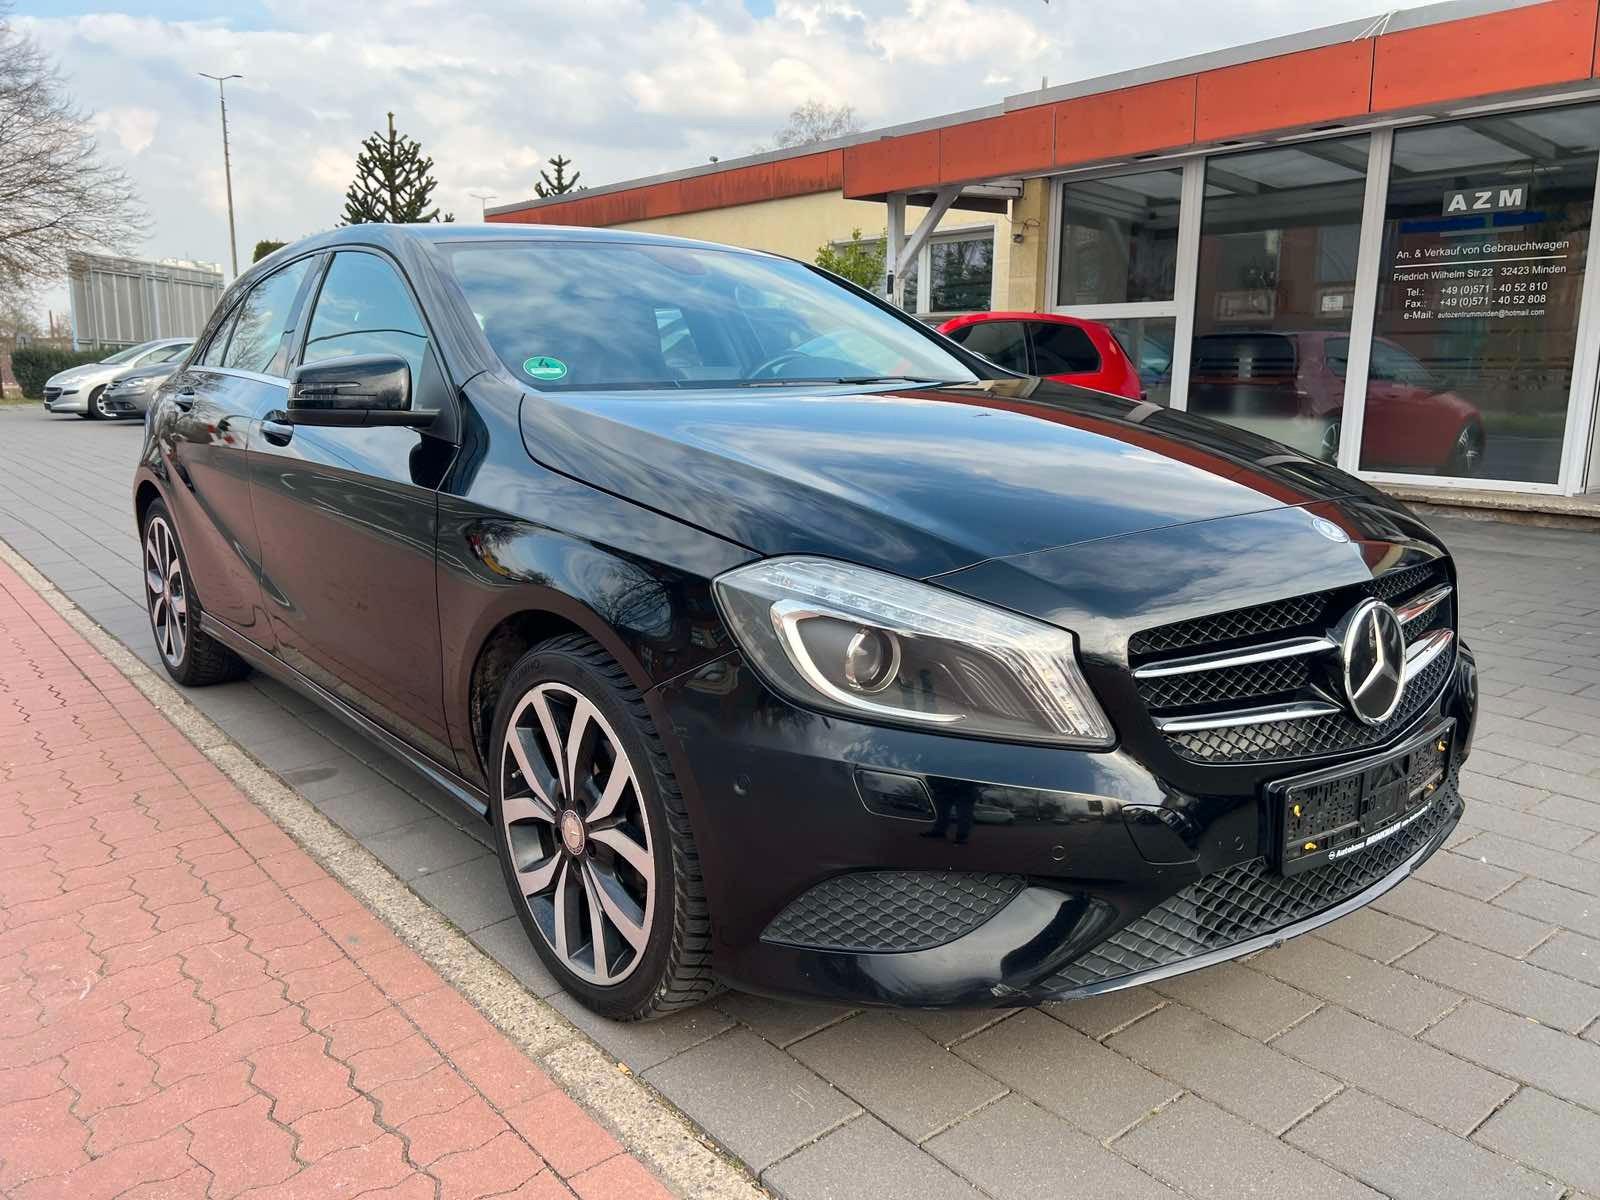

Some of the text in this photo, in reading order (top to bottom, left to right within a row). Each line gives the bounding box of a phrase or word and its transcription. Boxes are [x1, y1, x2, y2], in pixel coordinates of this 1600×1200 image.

[1447, 188, 1522, 212] AZM
[1396, 241, 1569, 259] An. & Verkauf von Gebrauchtwagen
[1393, 271, 1429, 281] Friedrich
[1431, 270, 1465, 280] Wilhelm
[1500, 266, 1530, 276] 32423
[1532, 265, 1567, 274] Minden
[1440, 286, 1458, 295] +49
[1460, 284, 1489, 296] (0)571
[1499, 283, 1512, 292] 40
[1514, 282, 1527, 292] 52
[1529, 281, 1548, 291] 810
[1440, 297, 1457, 306] +49
[1459, 296, 1489, 308] (0)571
[1497, 295, 1511, 305] 40
[1513, 295, 1525, 304] 52
[1527, 294, 1547, 304] 808
[1403, 310, 1434, 320] e-Mail:
